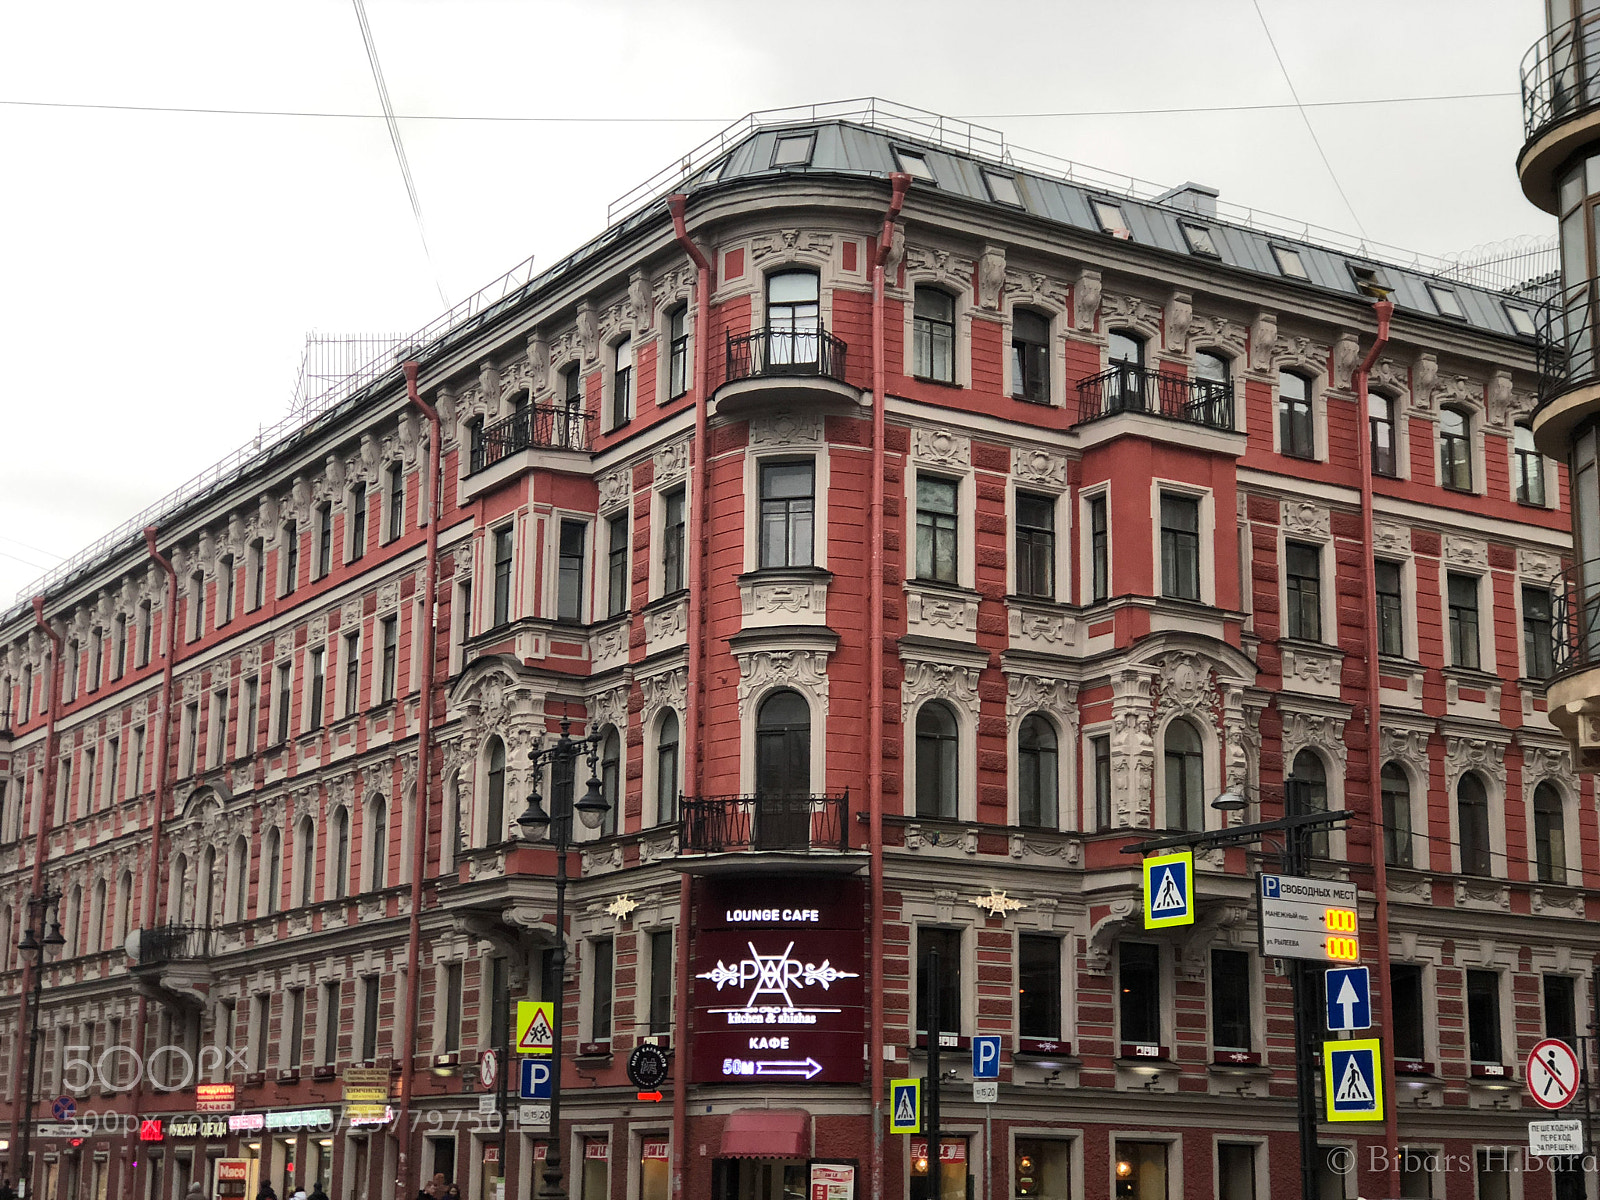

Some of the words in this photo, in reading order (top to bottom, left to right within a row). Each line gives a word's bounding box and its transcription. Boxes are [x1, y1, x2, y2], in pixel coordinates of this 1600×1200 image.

[1280, 883, 1331, 897] СВОБОДНЫХ
[1333, 890, 1355, 900] МЕСТ
[726, 909, 780, 922] LOUNGE
[782, 909, 819, 922] CAFE
[1265, 910, 1298, 919] МАНЕЖНЫЙ
[1326, 908, 1356, 932] 000
[1274, 938, 1299, 947] РЫЛЕЕВА
[1327, 936, 1357, 960] 000
[727, 1013, 764, 1024] kitchen
[777, 1013, 816, 1024] shishas
[749, 1037, 790, 1050] КАФЕ
[197, 1085, 235, 1095] ПРОДУКТЫ
[987, 1088, 995, 1097] 20
[531, 1111, 538, 1119] 15
[539, 1110, 550, 1119] 20
[1531, 1123, 1579, 1132] ПЕШЕХОДНЫЙ
[1541, 1134, 1571, 1142] ПЕРЕХОД
[220, 1165, 245, 1178] Мясо
